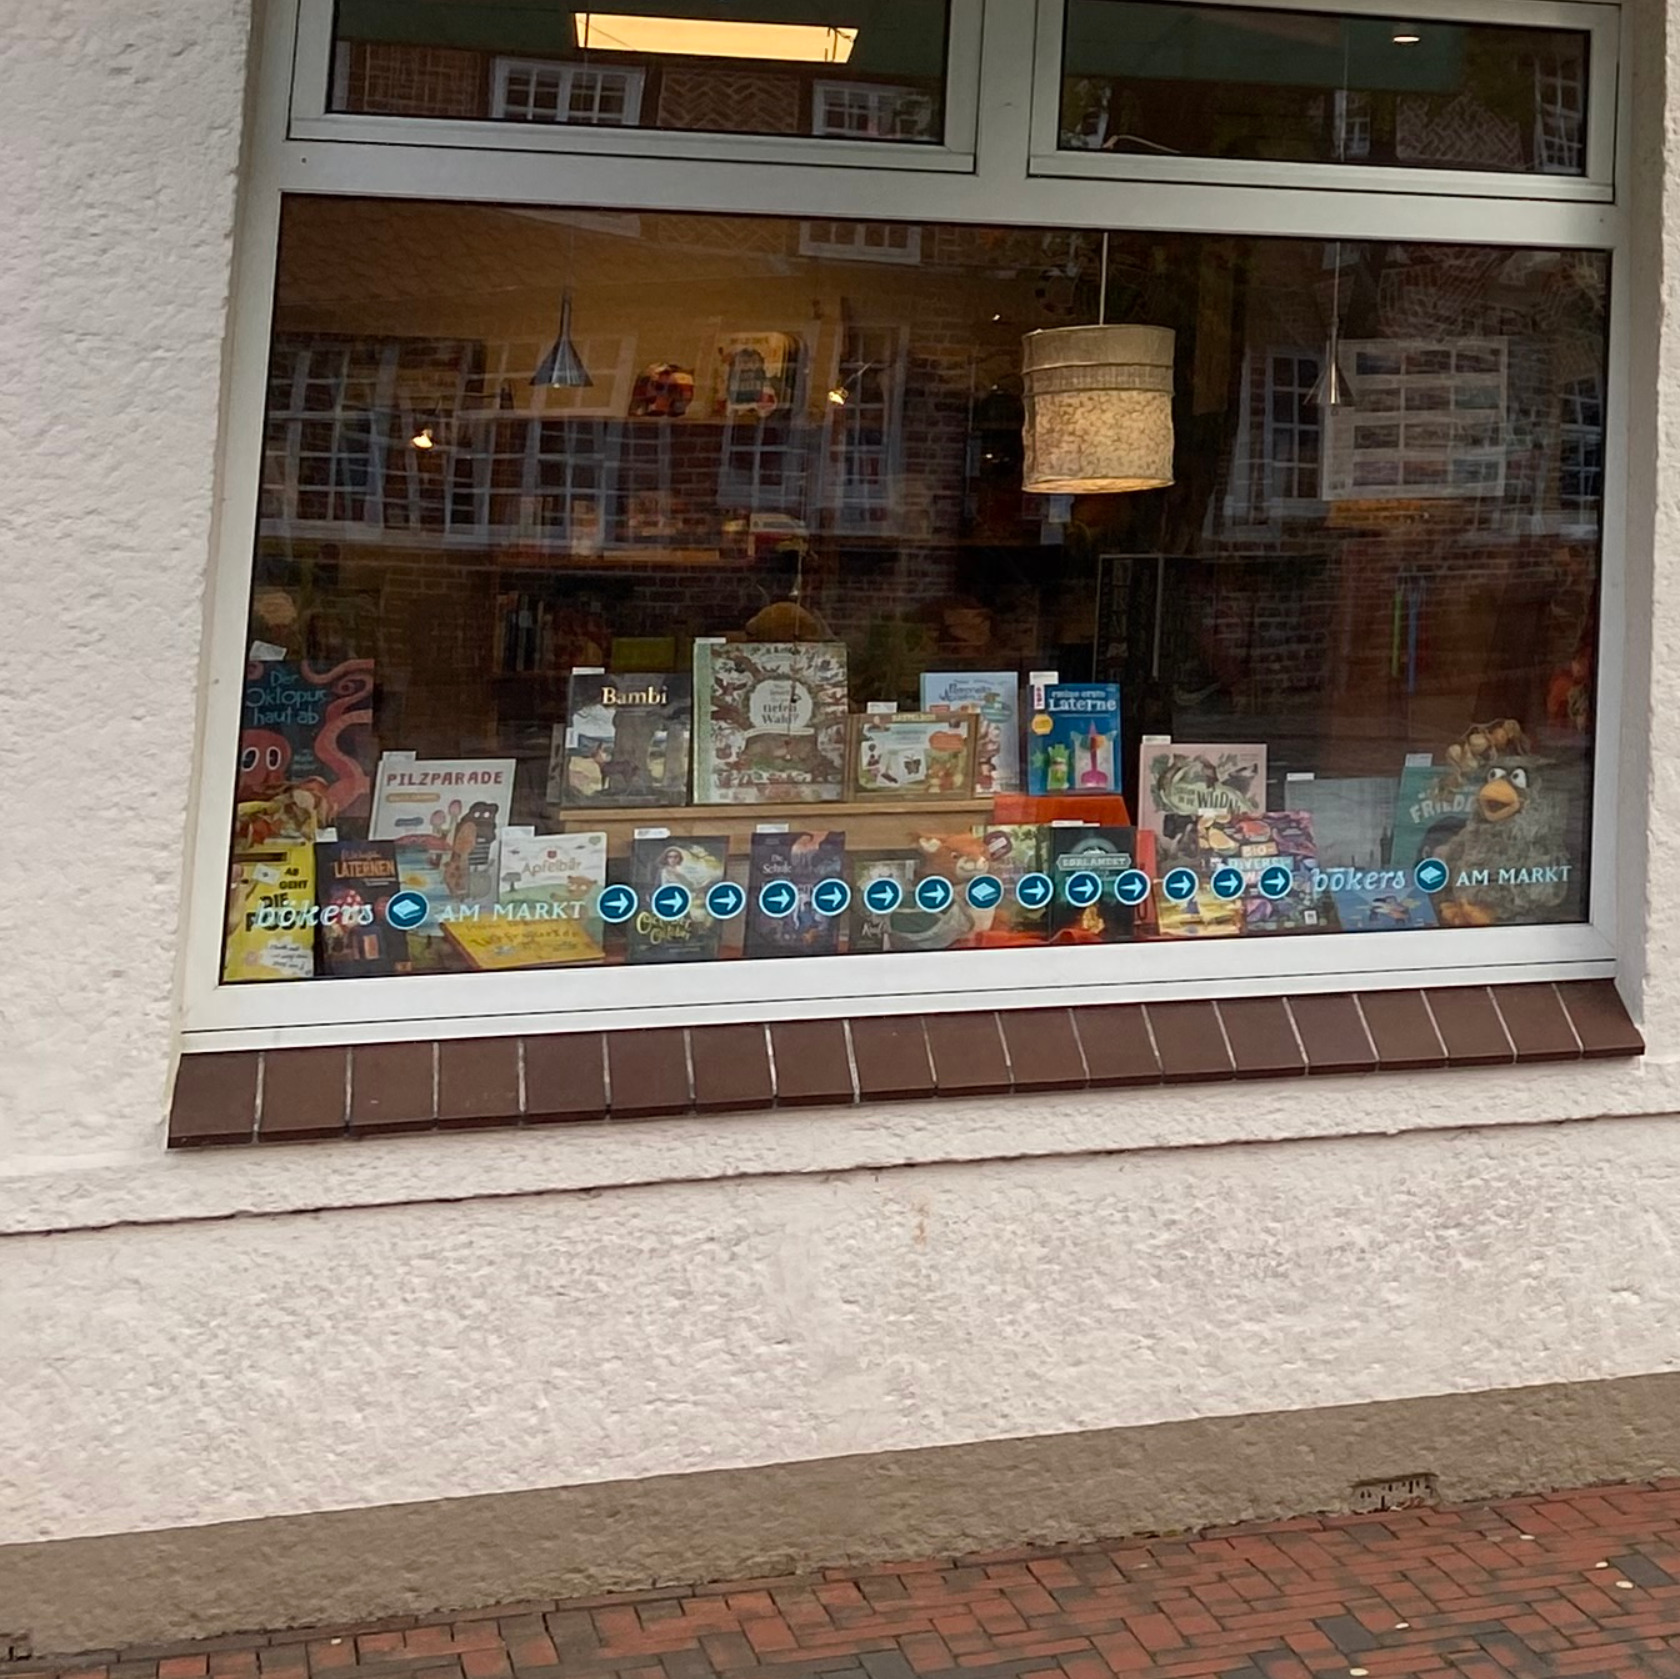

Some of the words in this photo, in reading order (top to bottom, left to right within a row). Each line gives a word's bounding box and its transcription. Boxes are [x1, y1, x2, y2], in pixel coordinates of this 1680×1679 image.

[601, 685, 668, 706] Bambi
[1048, 698, 1118, 712] Laterne
[386, 770, 504, 786] PILZPARADE
[334, 860, 396, 879] LATERNEN
[1455, 869, 1489, 888] AM
[1497, 865, 1573, 885] MARKT
[252, 900, 374, 928] bökers
[438, 904, 481, 923] AM
[492, 901, 587, 922] MARKT
